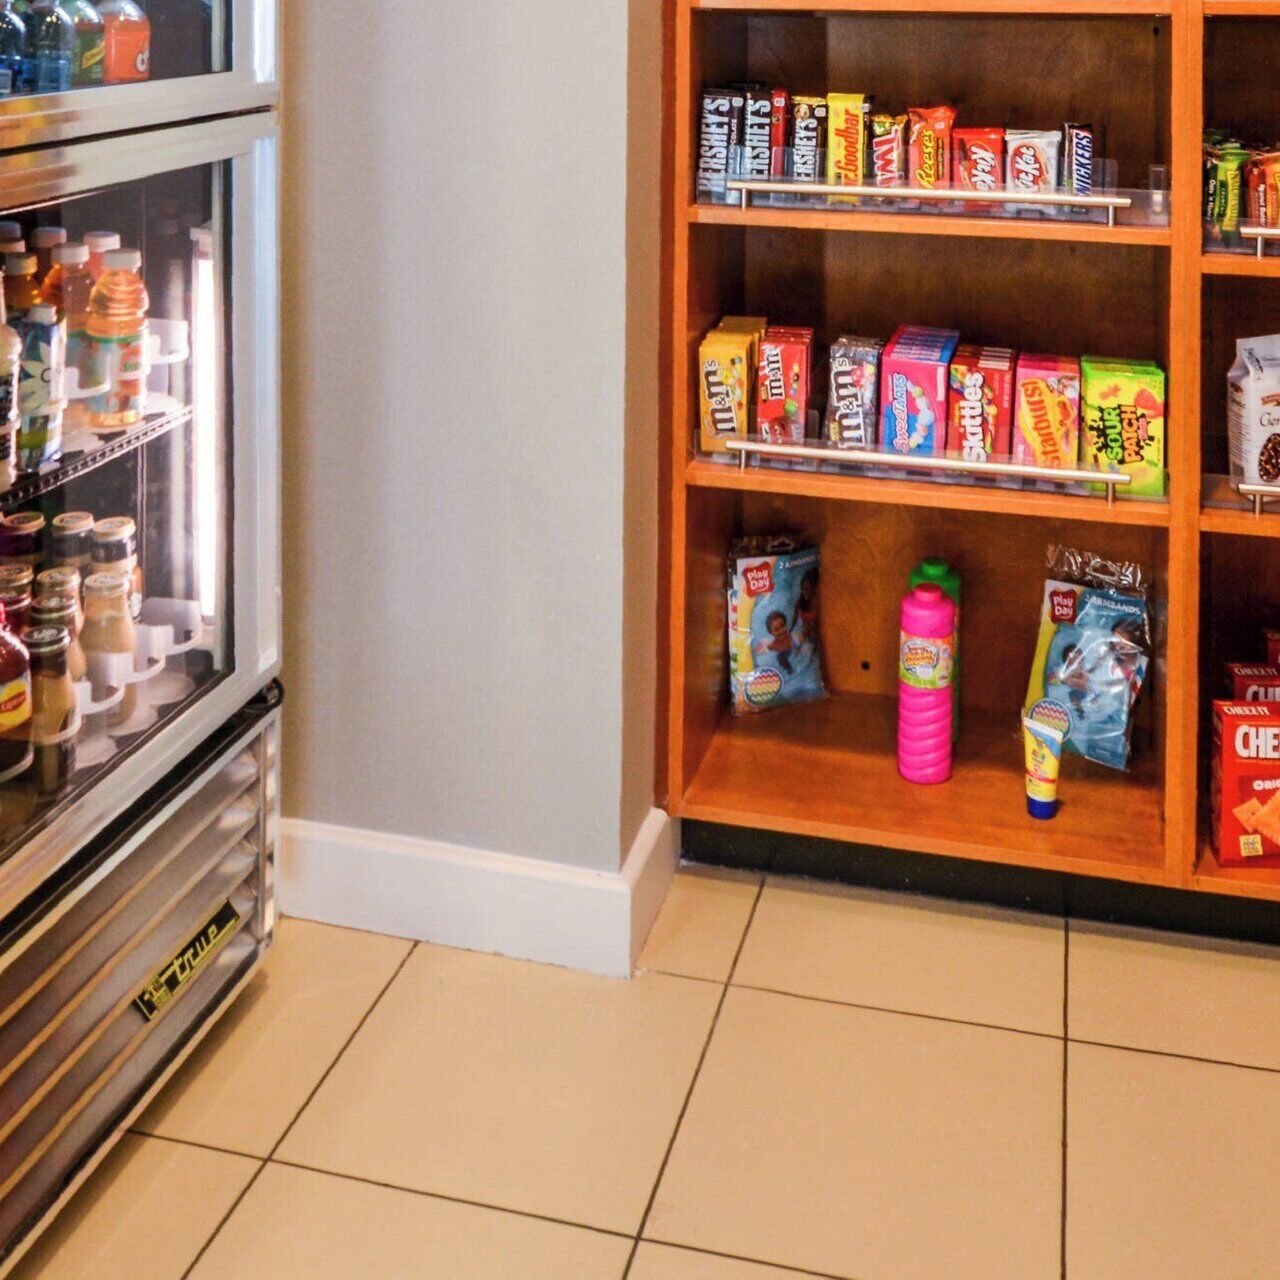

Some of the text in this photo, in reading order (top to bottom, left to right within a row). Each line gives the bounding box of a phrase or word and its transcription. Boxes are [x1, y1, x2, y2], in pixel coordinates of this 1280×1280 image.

[746, 99, 771, 180] ERSHEY'S
[793, 118, 818, 182] ERSHEY'S
[1073, 131, 1093, 197] NICKERS
[704, 359, 737, 434] m&m's
[893, 372, 910, 453] SweeTARTS
[959, 371, 987, 463] Skittles
[1103, 406, 1123, 461] SOUR
[1120, 404, 1144, 464] PATCH
[1054, 605, 1074, 617] Day
[159, 923, 218, 982] true
